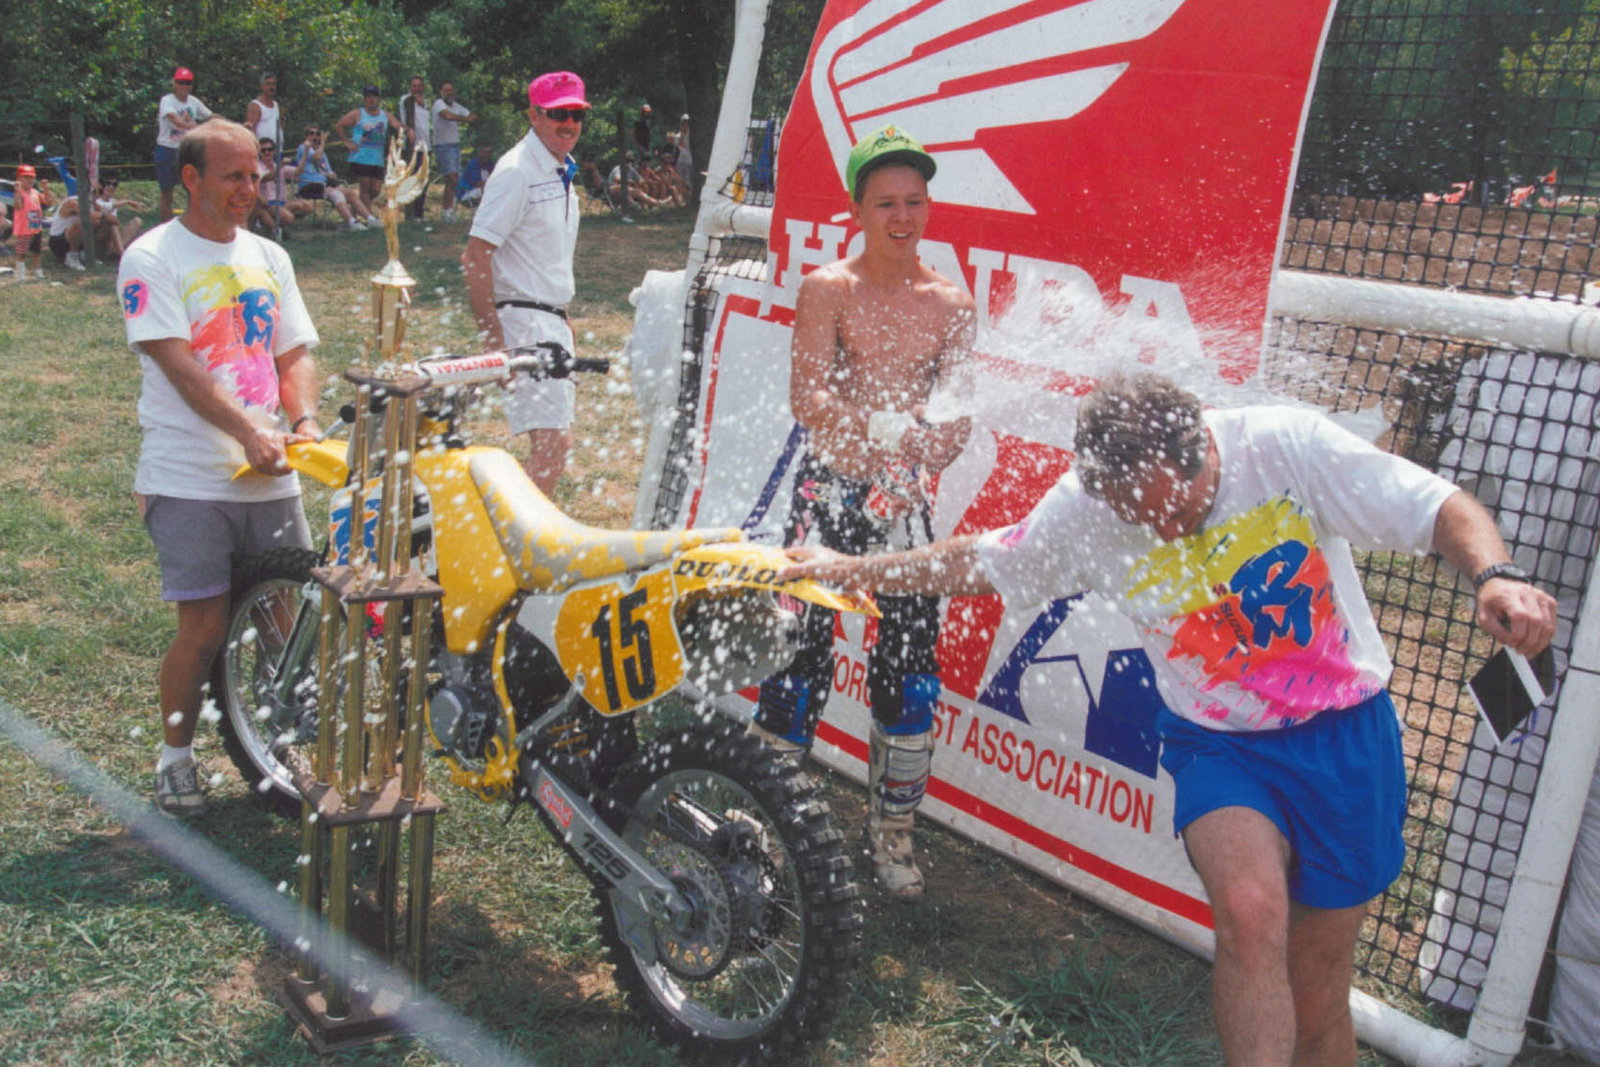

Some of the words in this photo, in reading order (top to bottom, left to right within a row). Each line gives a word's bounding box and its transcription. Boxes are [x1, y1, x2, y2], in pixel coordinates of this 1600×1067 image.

[673, 559, 785, 587] DUNLO
[591, 586, 656, 711] 15
[962, 716, 1154, 834] ASSOCIATION
[582, 832, 631, 880] 125
